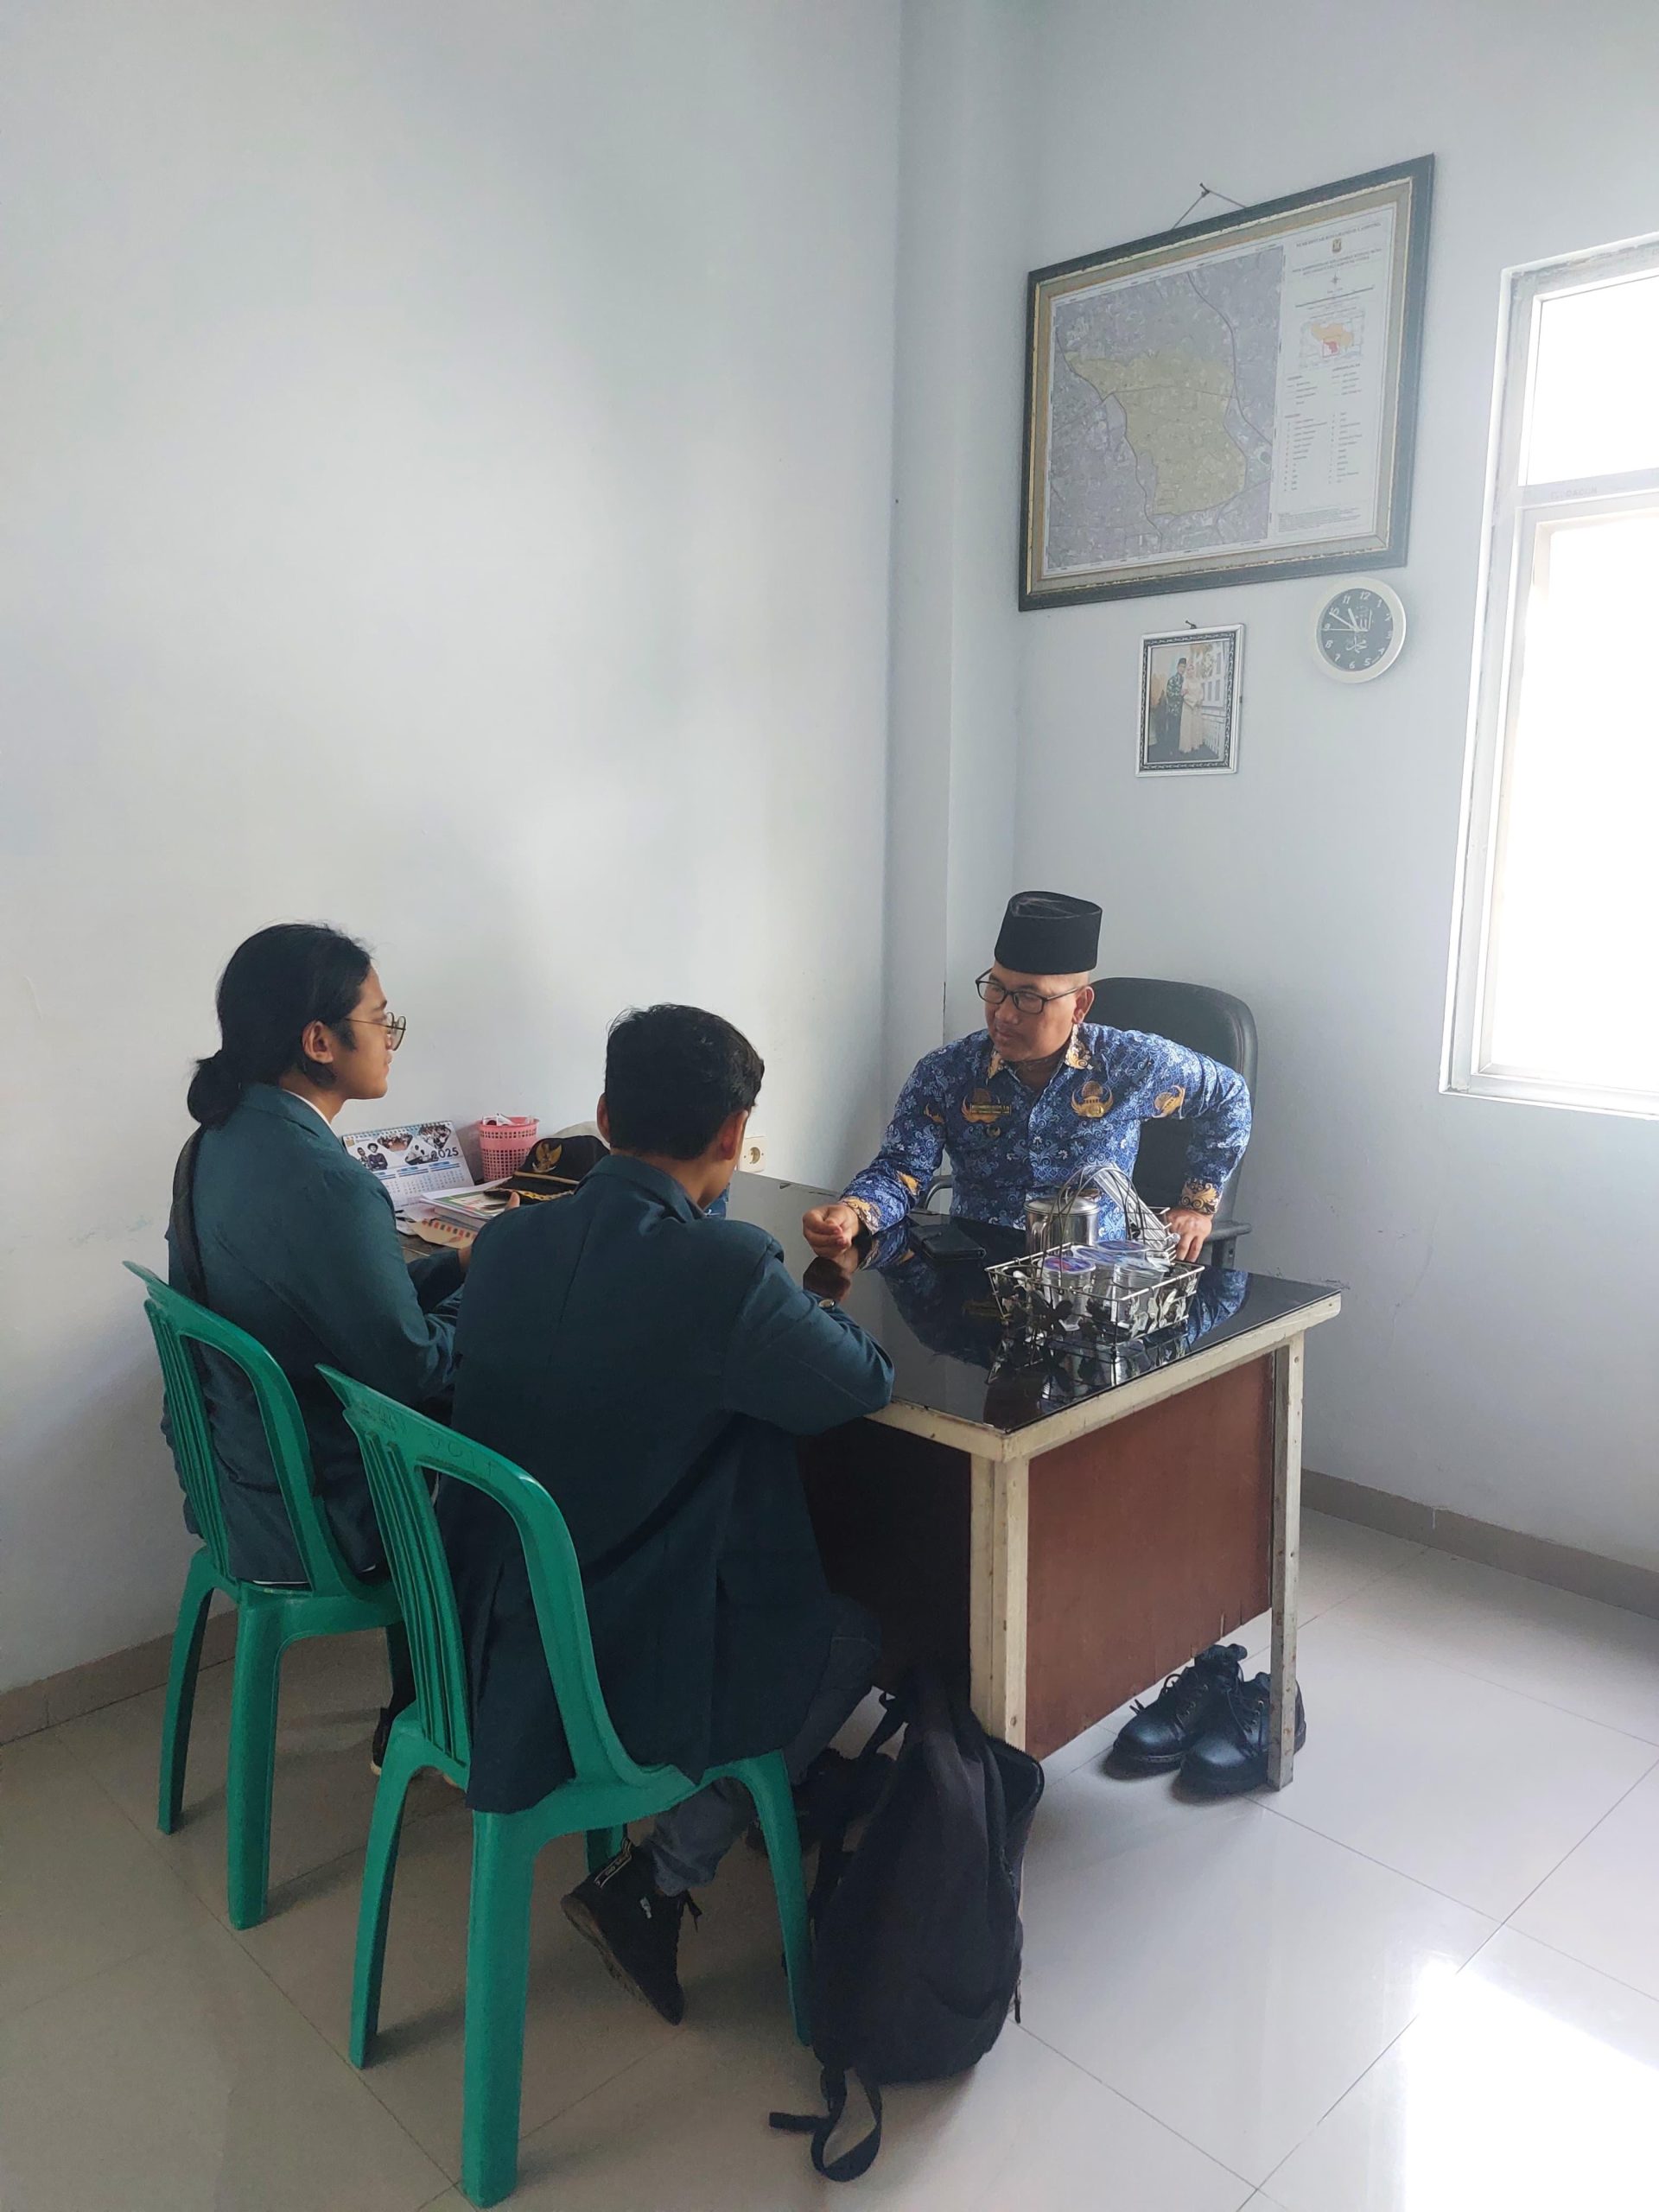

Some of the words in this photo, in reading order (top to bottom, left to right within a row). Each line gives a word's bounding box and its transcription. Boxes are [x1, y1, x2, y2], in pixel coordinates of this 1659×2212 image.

[1342, 594, 1351, 604] 11
[1359, 591, 1371, 600] 12
[1376, 599, 1382, 607] 1
[1334, 653, 1340, 662] 7
[1363, 658, 1371, 666] 5
[430, 1147, 459, 1160] 2025
